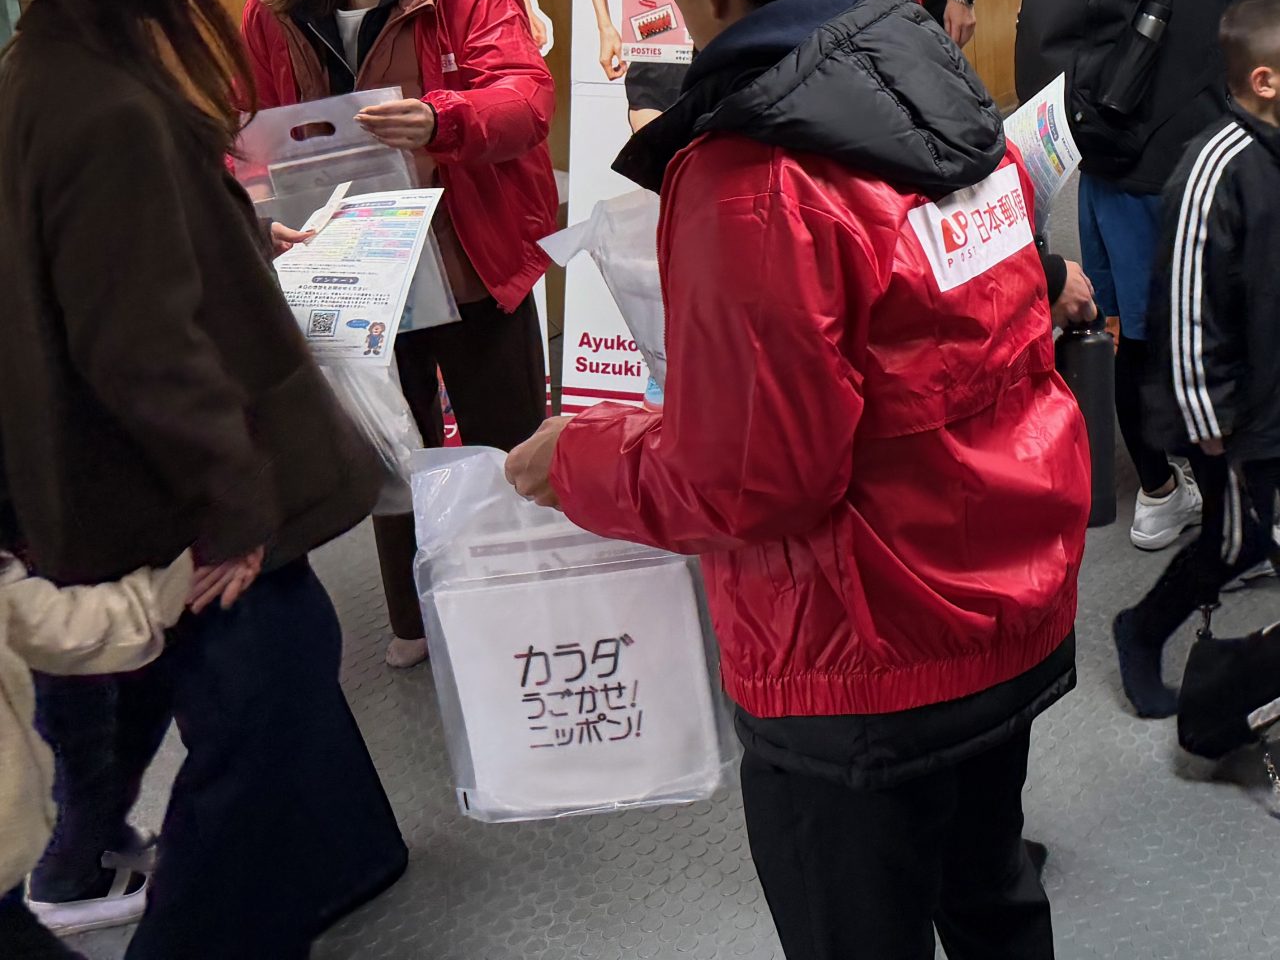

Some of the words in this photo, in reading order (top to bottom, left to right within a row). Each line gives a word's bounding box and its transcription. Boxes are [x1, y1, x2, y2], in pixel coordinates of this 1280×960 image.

[578, 332, 639, 352] Ayuko
[575, 356, 642, 377] Suzuki
[514, 634, 634, 687] カラダ
